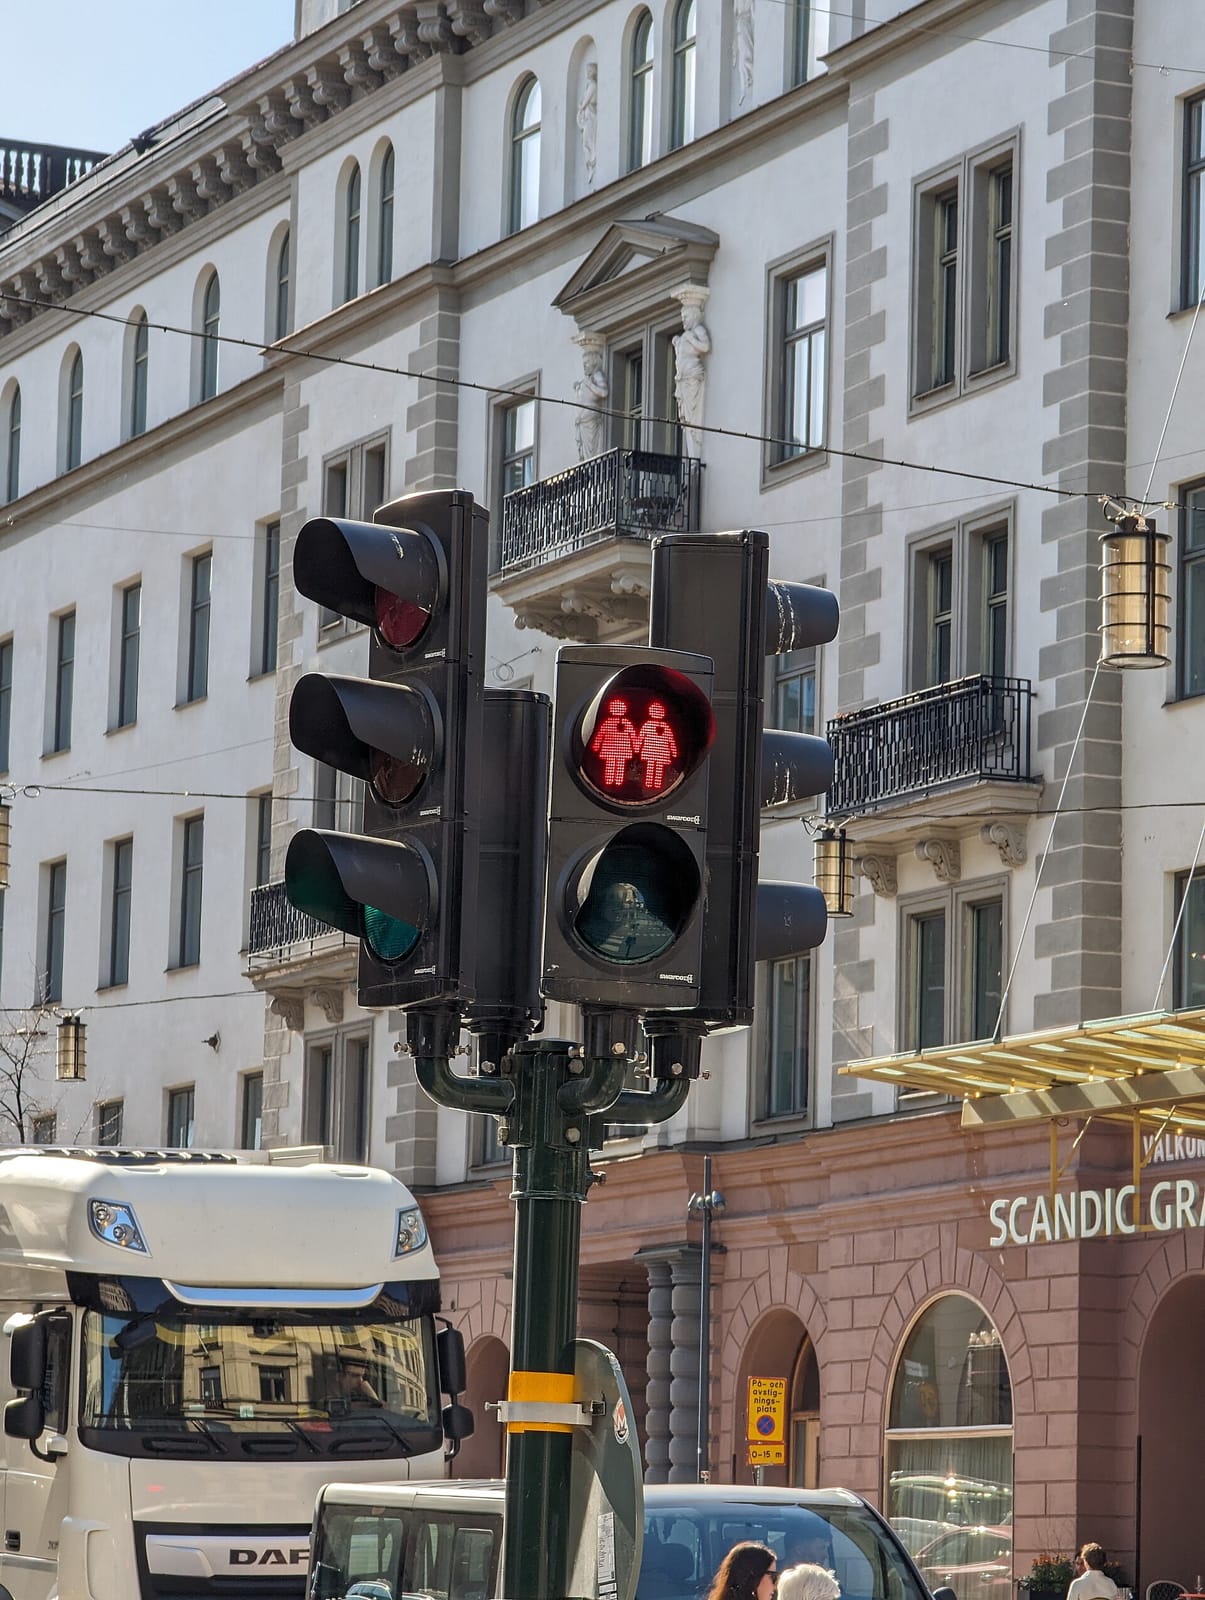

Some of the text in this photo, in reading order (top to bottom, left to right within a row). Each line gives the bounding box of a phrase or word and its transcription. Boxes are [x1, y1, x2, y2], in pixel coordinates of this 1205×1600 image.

[989, 1180, 1205, 1246] SCANDIC GR
[769, 1381, 784, 1389] och
[752, 1389, 783, 1398] avstig-
[753, 1397, 781, 1406] nings-
[756, 1405, 777, 1413] plats
[751, 1450, 771, 1458] 0-15
[229, 1549, 310, 1565] DAF
